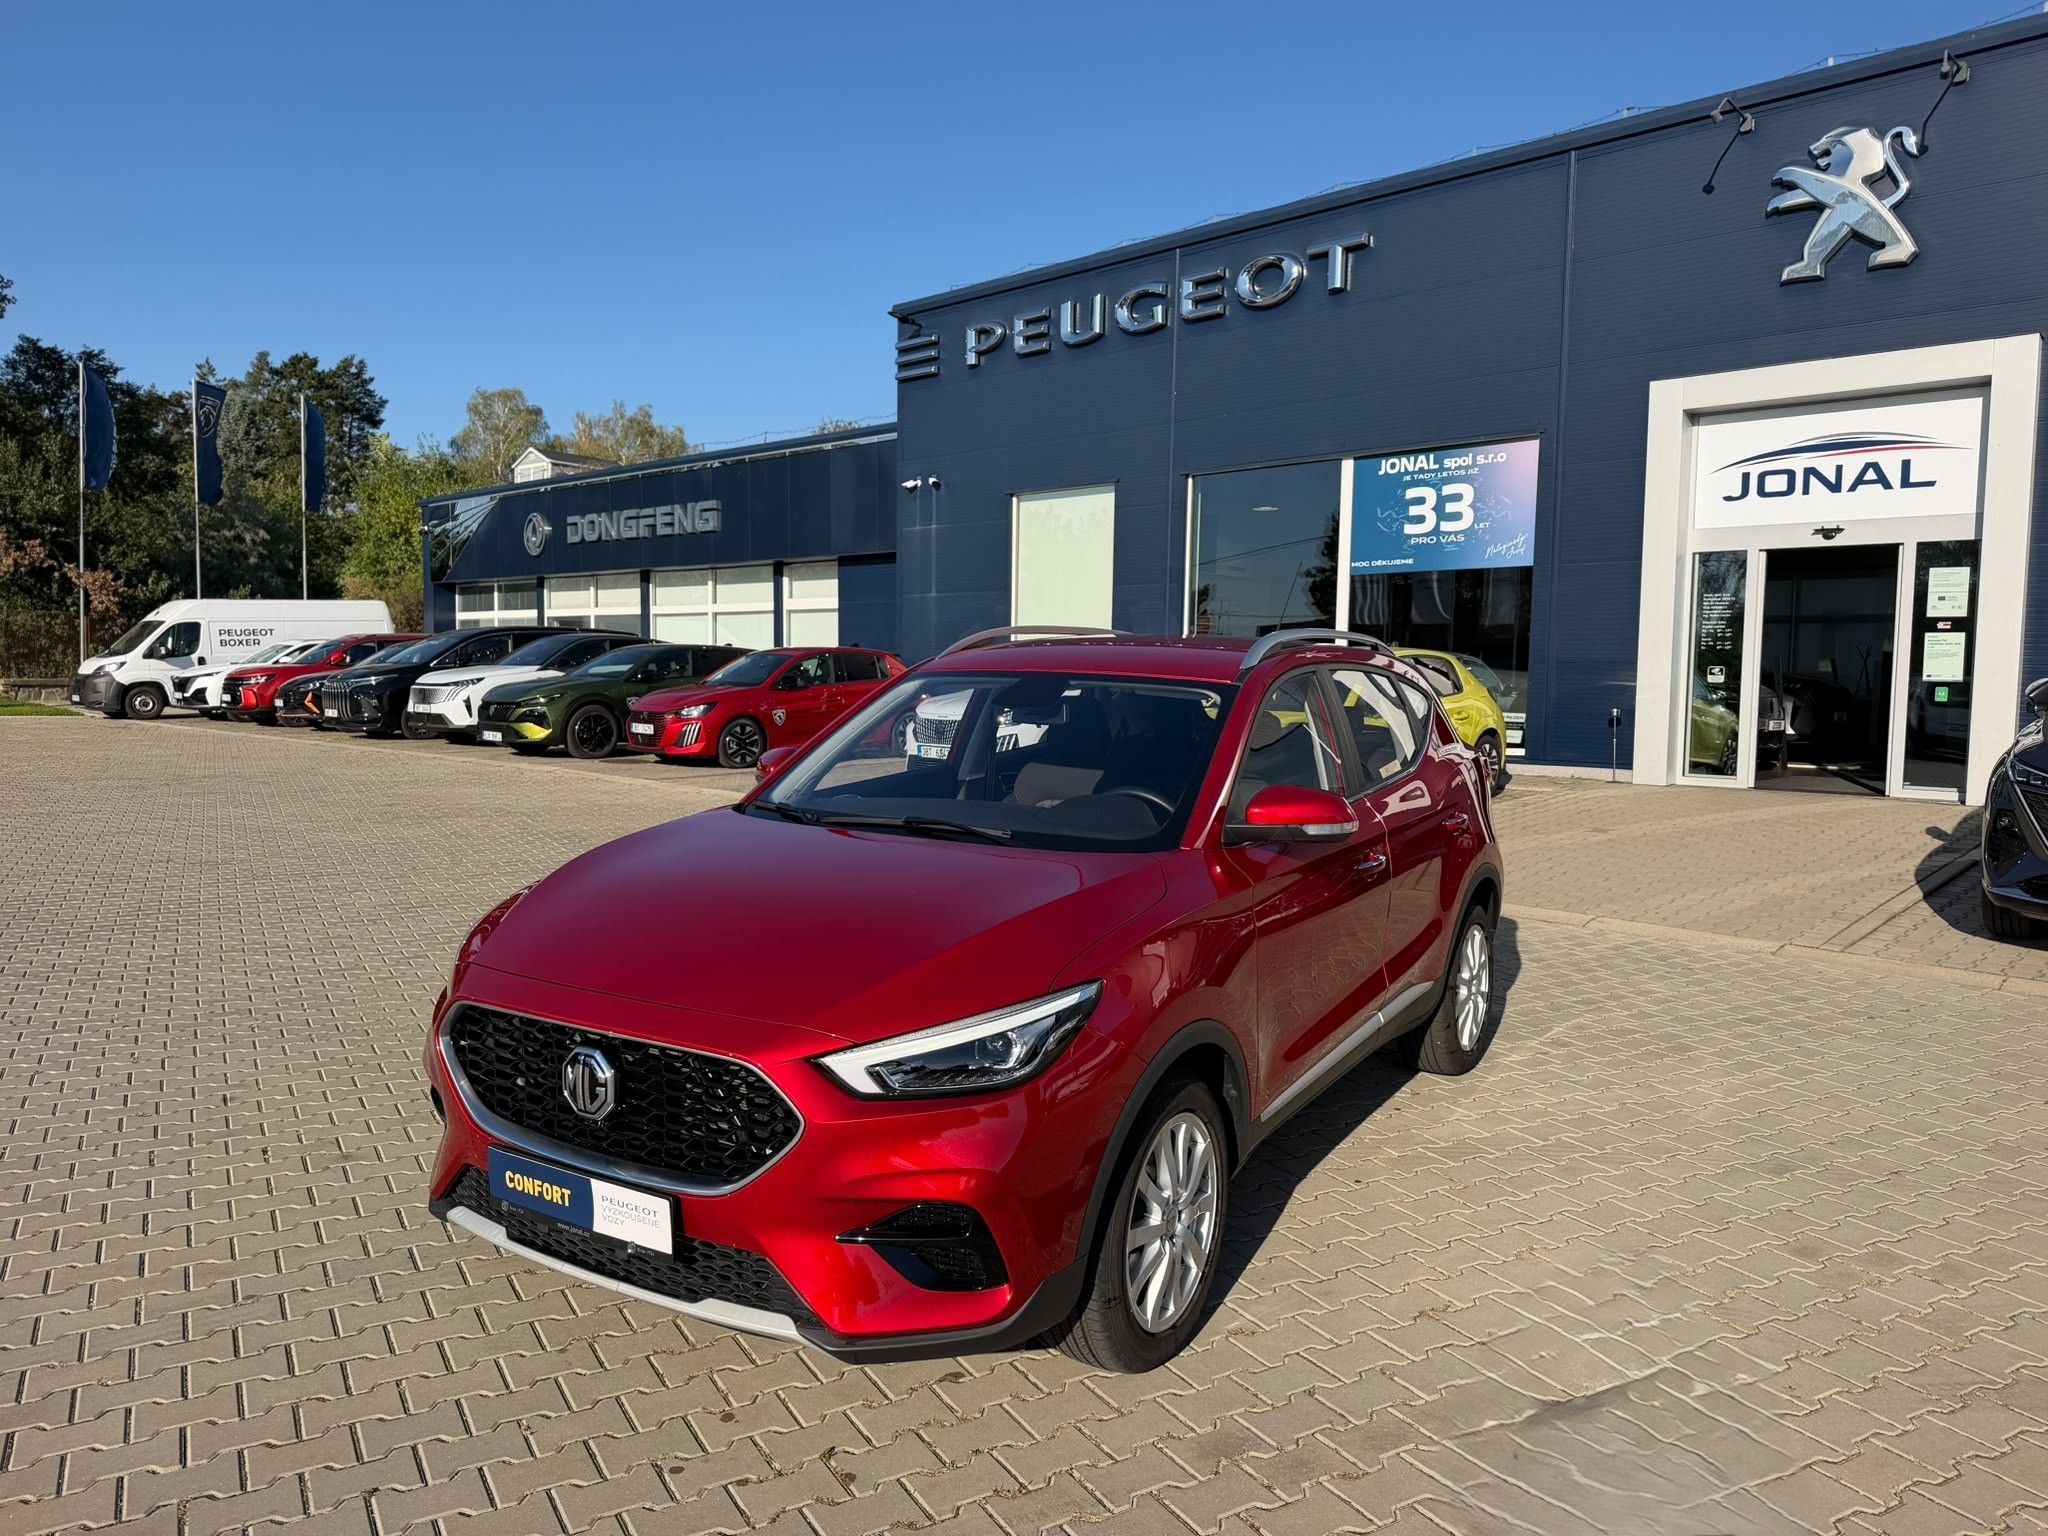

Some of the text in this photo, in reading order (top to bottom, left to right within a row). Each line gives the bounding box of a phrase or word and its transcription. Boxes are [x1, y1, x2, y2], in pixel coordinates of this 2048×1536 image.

[965, 232, 1372, 368] PEUGEOT
[1378, 452, 1507, 476] JONAL spol s.r.o
[1413, 472, 1436, 480] TADY
[1437, 469, 1466, 478] LETOS
[1722, 459, 1938, 502] JONAL
[1403, 483, 1475, 535] 33
[566, 500, 721, 545] DONGFENG
[1411, 533, 1465, 545] PRO VÁS
[1371, 558, 1414, 567] DĚKUJEME
[218, 628, 275, 637] PEUGEOT
[220, 638, 261, 647] BOXER
[565, 1054, 607, 1114] MG
[505, 1170, 571, 1207] CONFORT
[601, 1195, 657, 1218] PEUGEOT
[601, 1212, 625, 1226] VOZY
